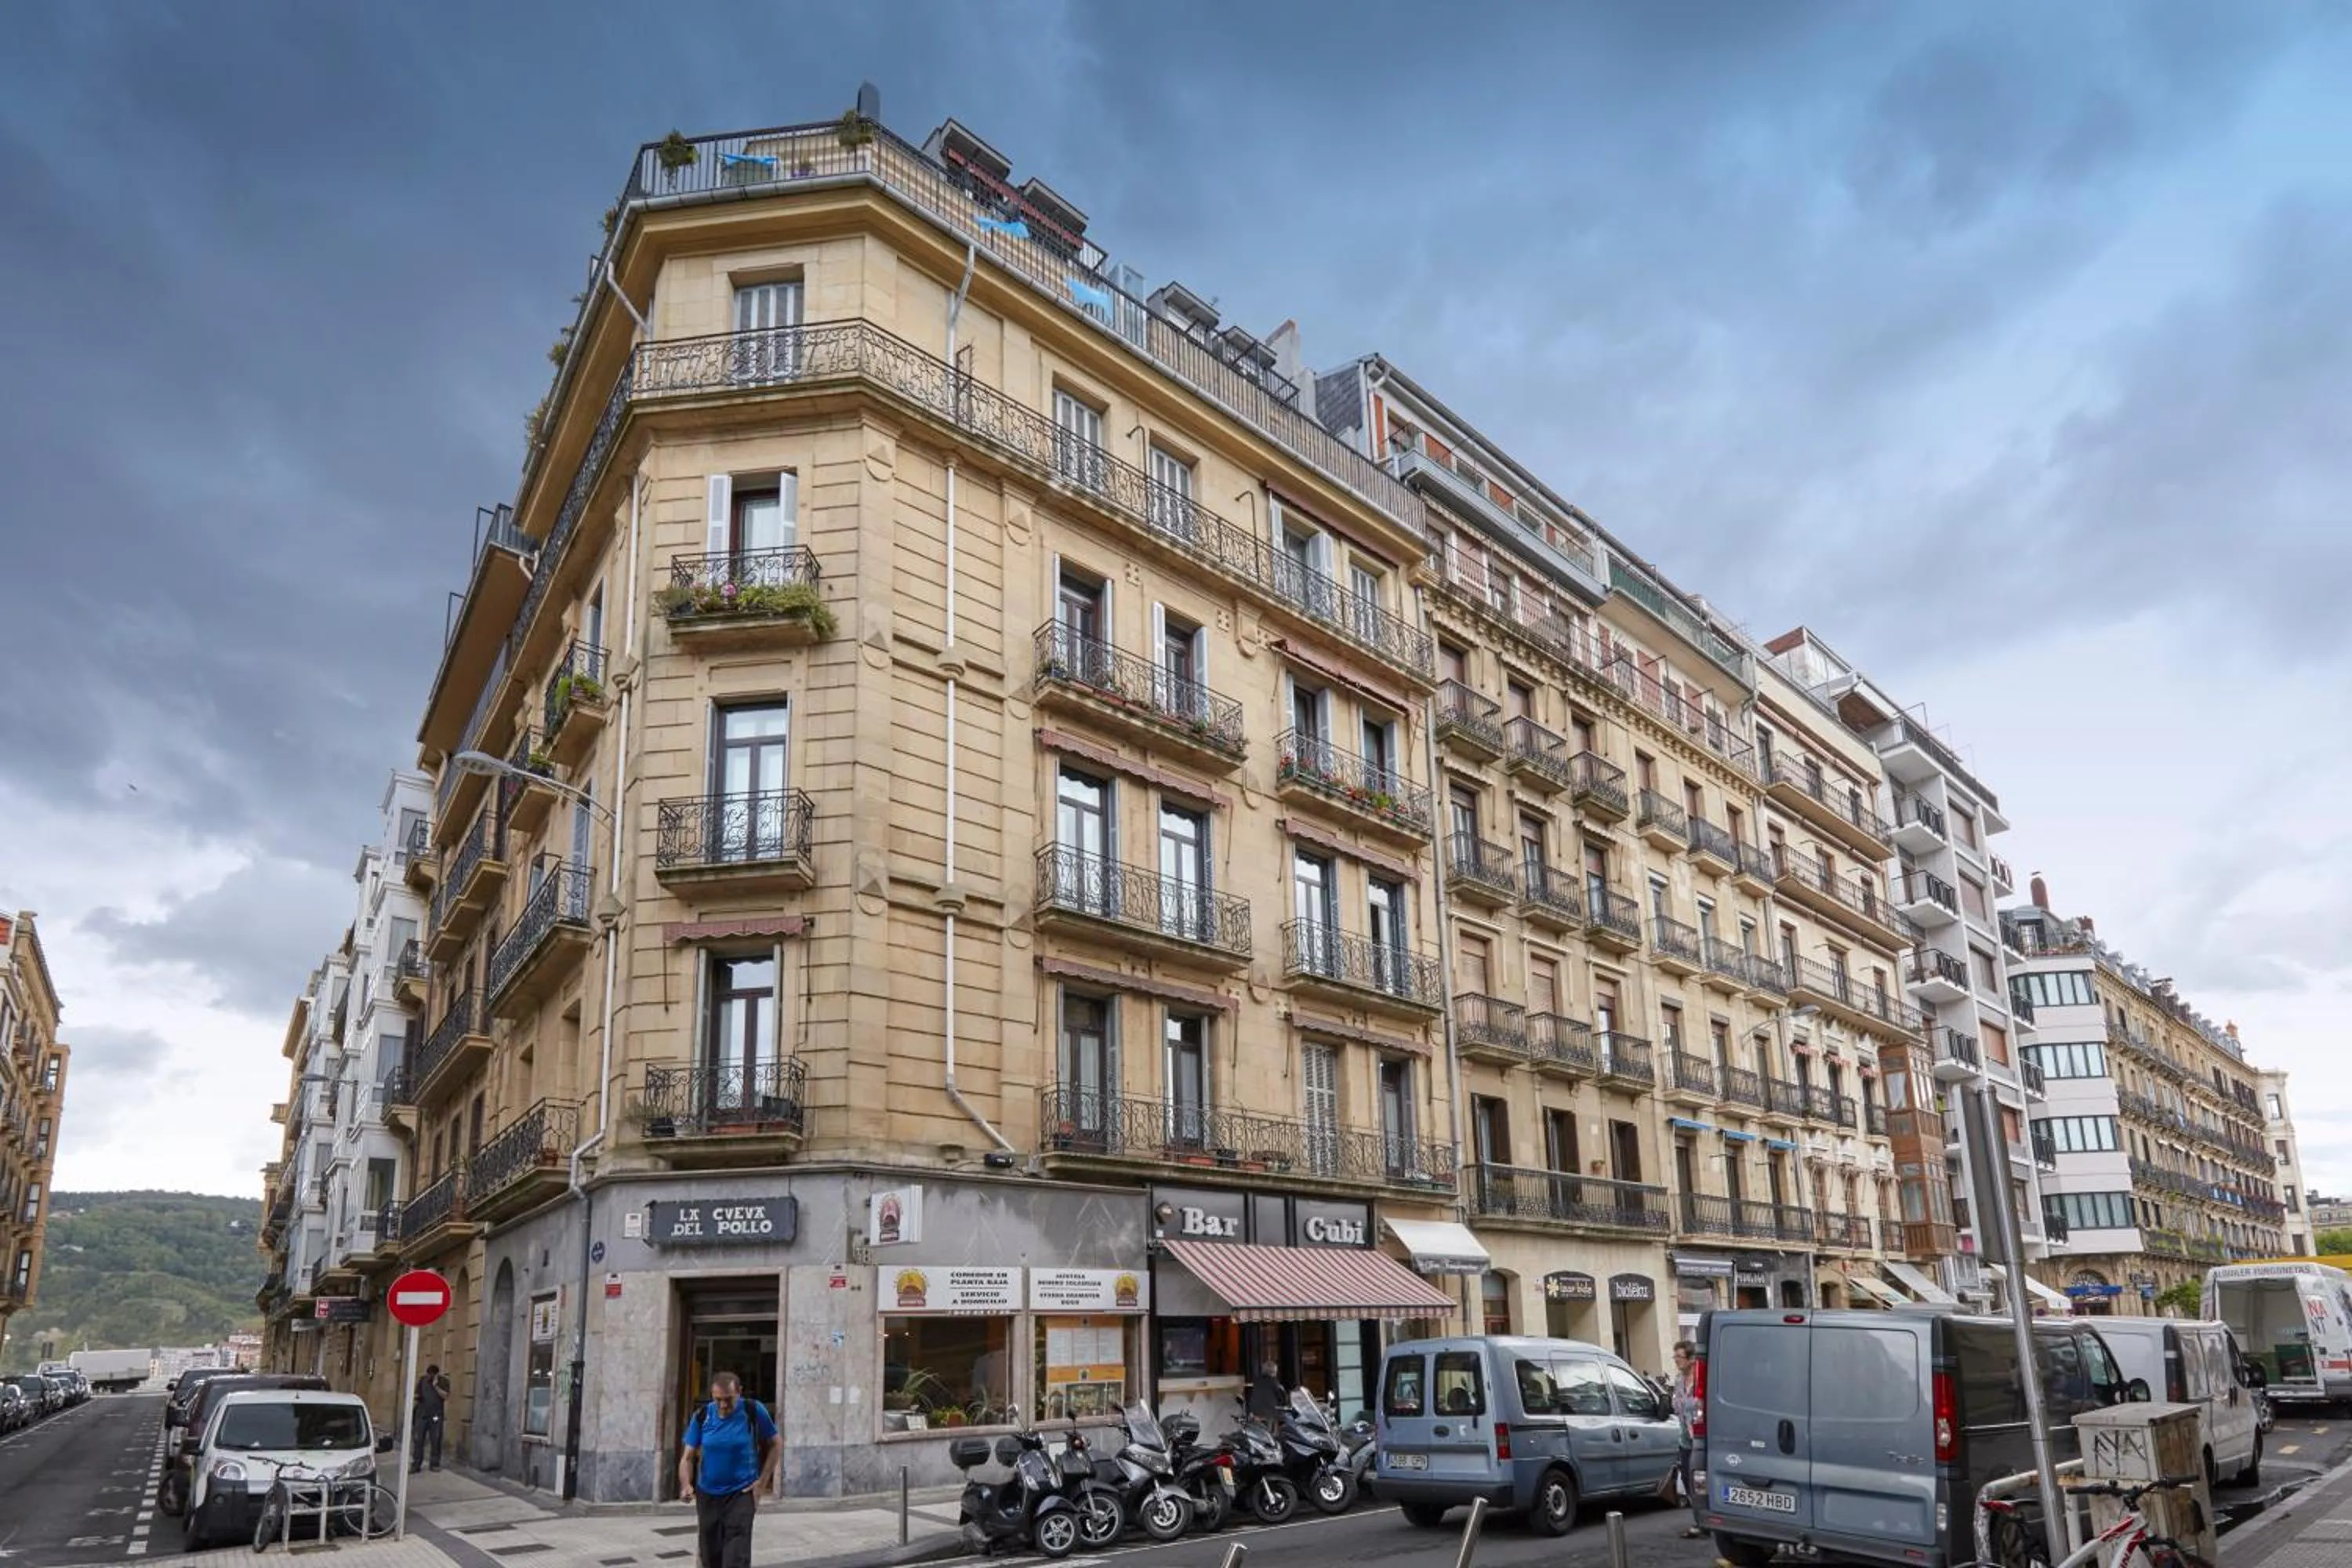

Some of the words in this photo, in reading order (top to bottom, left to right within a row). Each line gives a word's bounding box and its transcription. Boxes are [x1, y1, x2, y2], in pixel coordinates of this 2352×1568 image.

[680, 1208, 699, 1221] LA
[671, 1223, 703, 1236] DEL
[717, 1220, 772, 1234] POLLO
[1181, 1206, 1239, 1236] Bar
[1305, 1216, 1365, 1244] Cubi
[1730, 1489, 1763, 1505] 2652
[1766, 1494, 1791, 1509] HBD
